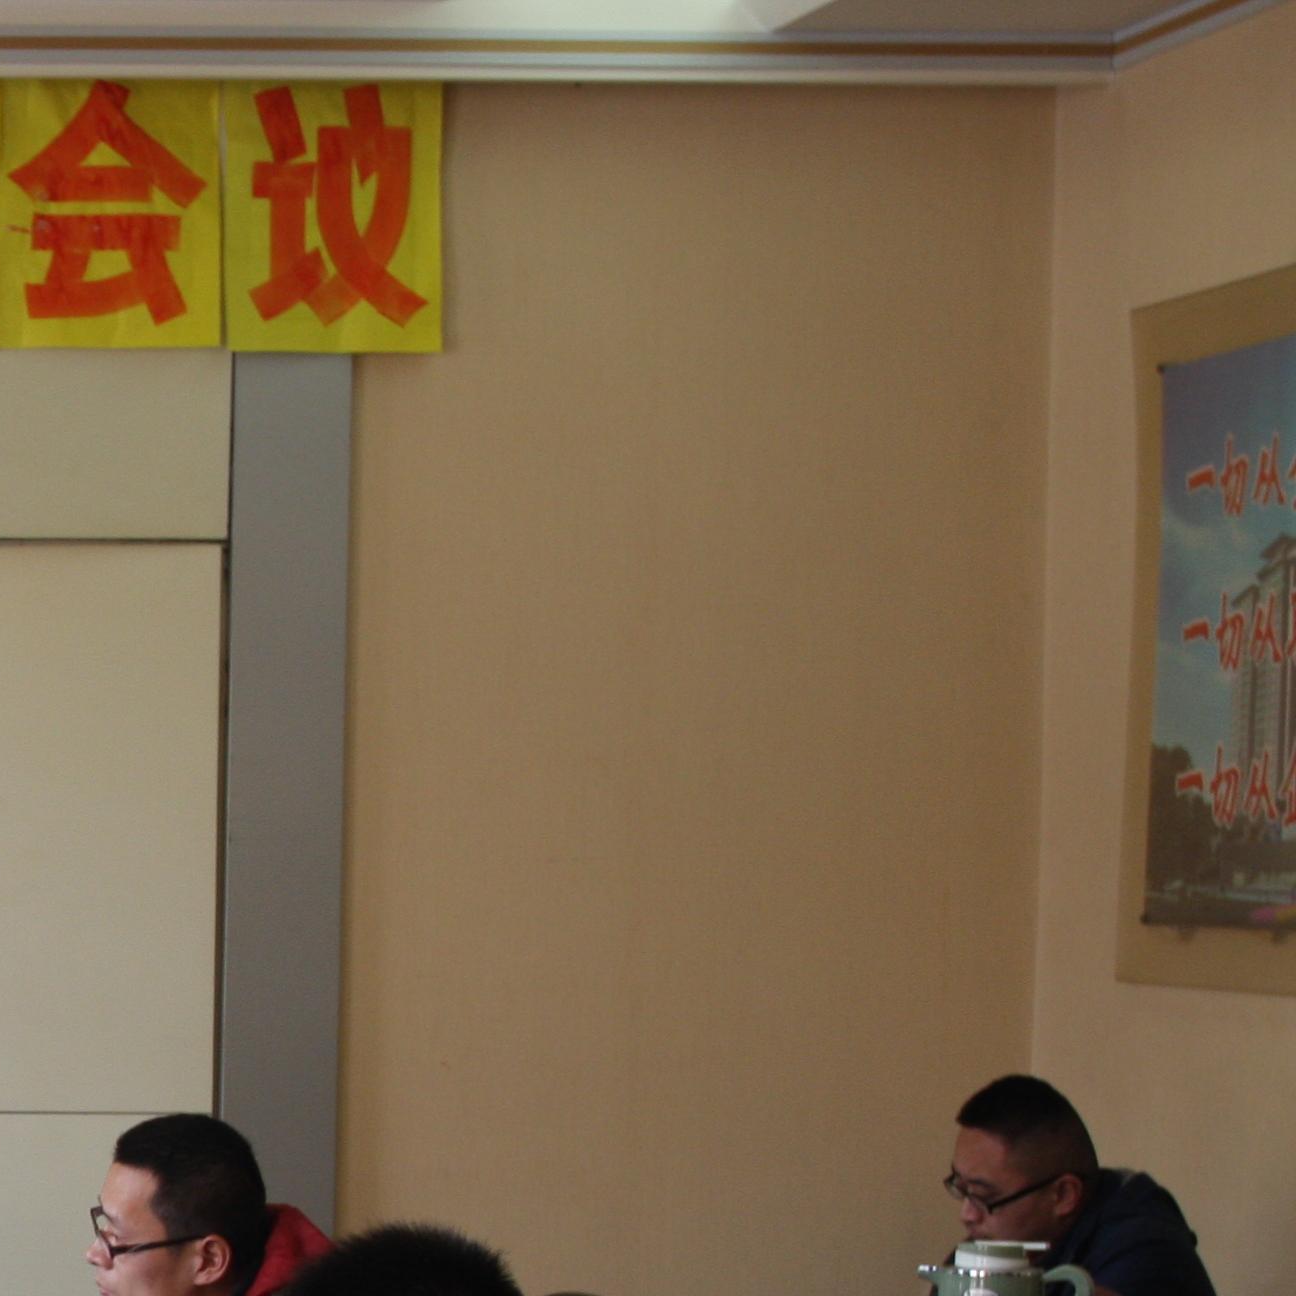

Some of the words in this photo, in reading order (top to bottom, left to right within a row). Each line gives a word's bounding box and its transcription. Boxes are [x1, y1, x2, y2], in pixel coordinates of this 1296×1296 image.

[1185, 433, 1296, 518] 一切从
[1182, 591, 1296, 671] 一切从
